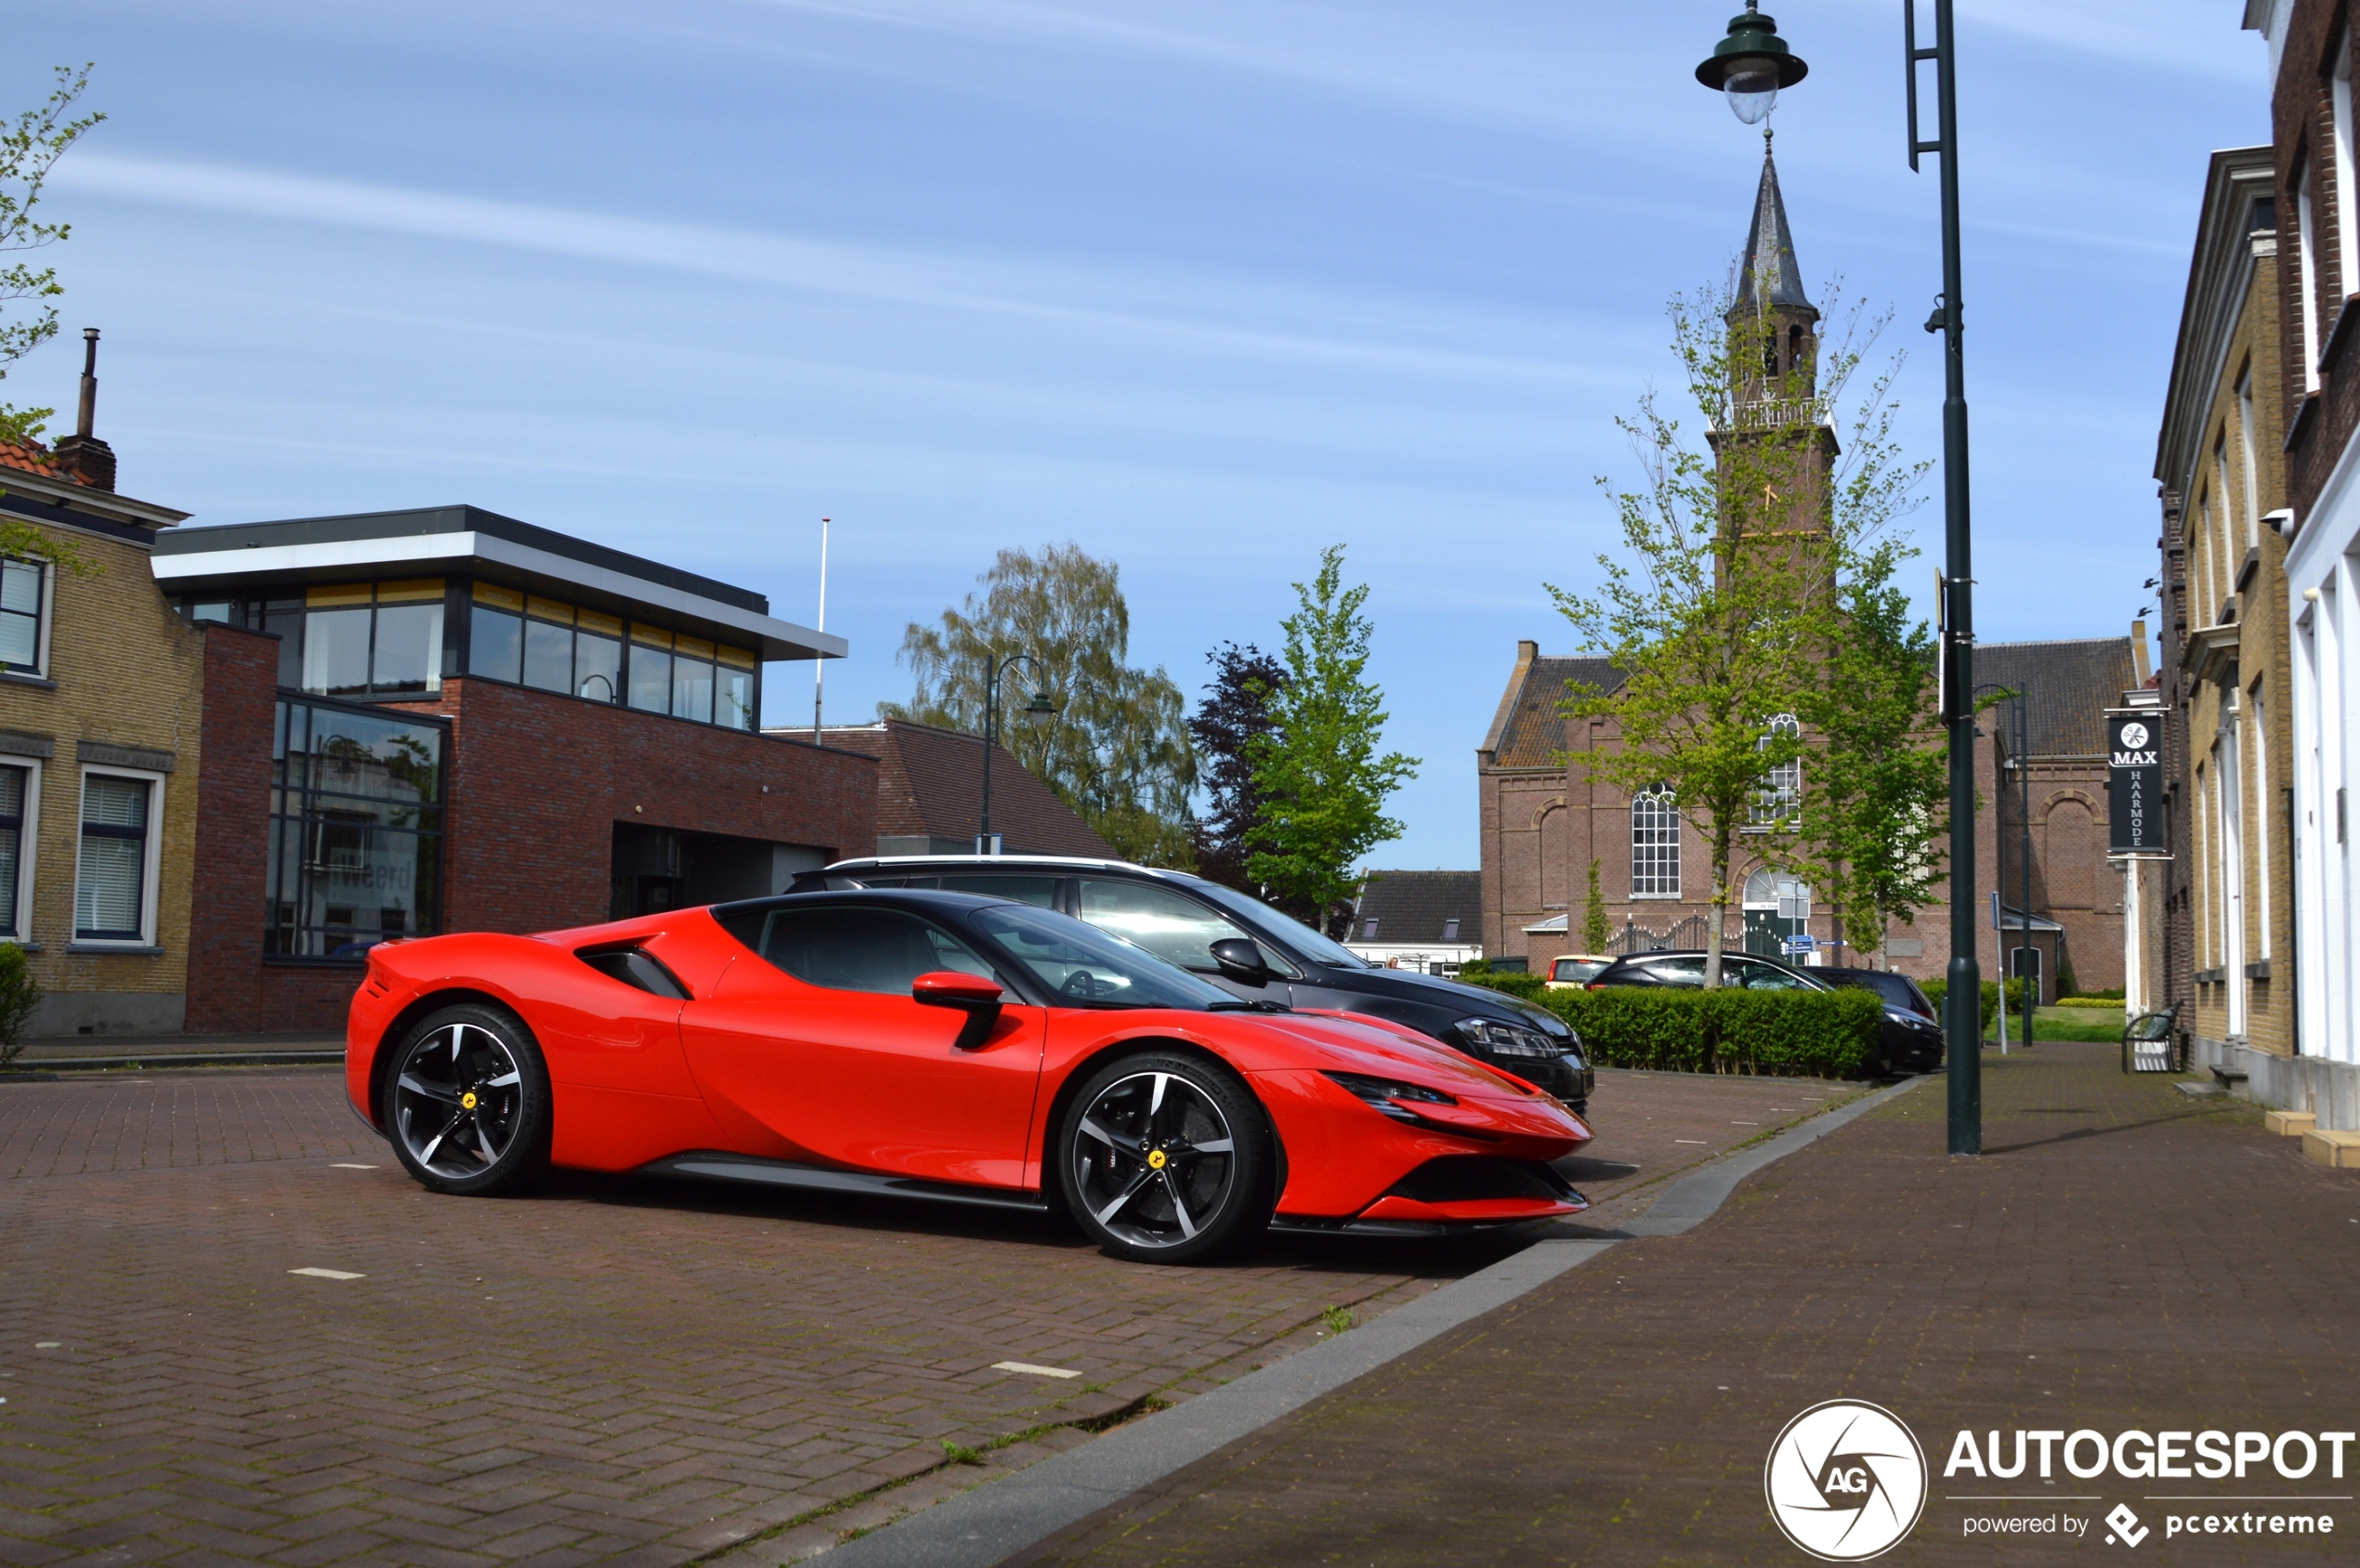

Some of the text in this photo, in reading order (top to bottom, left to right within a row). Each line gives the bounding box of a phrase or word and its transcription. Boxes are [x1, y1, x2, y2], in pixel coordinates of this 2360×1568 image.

[2114, 751, 2157, 764] MAX
[2131, 771, 2144, 846] HAARMODE
[340, 854, 412, 891] Weerd
